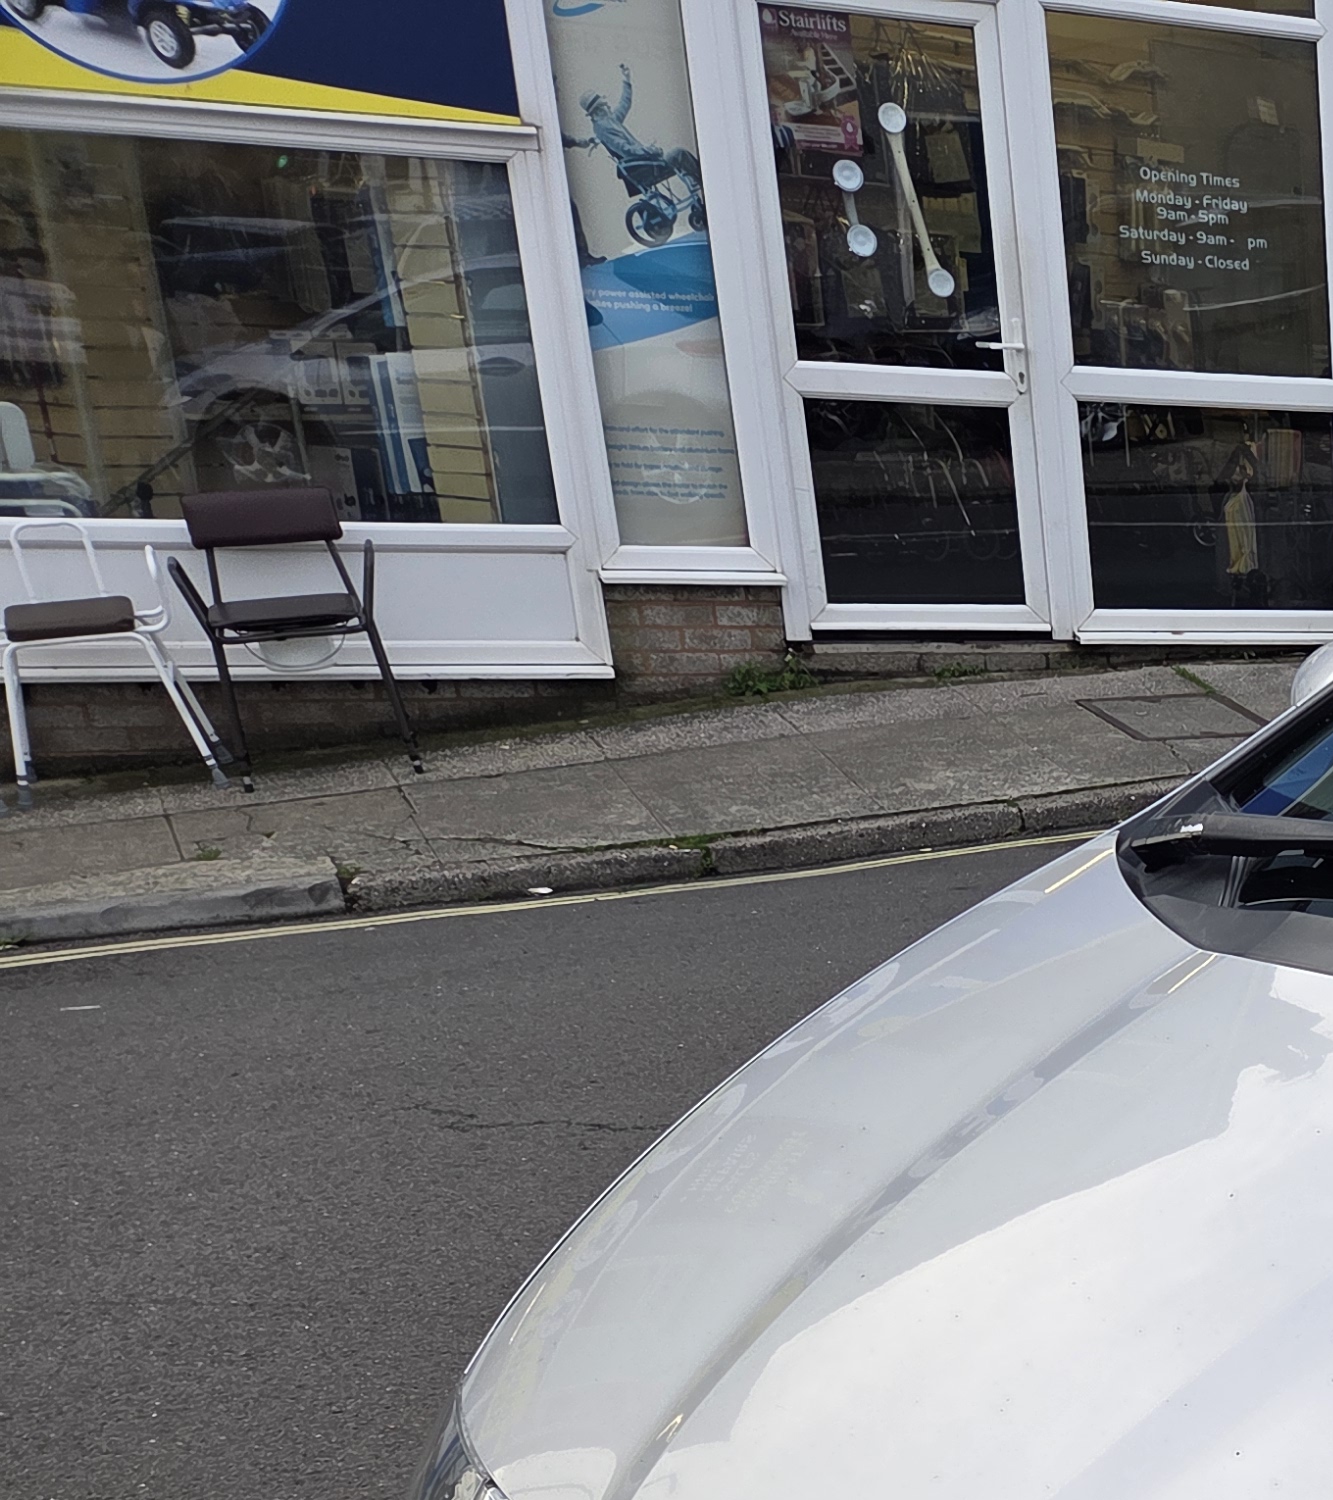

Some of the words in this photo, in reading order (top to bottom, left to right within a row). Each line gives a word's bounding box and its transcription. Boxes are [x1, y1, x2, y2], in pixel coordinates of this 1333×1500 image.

[778, 10, 847, 32] Stairlifts
[1139, 167, 1197, 187] Opening
[1200, 172, 1240, 188] Times
[1136, 189, 1191, 209] Monday
[1203, 195, 1247, 213] Friday
[1156, 206, 1188, 222] 9am
[1198, 209, 1229, 226] 5pm
[1119, 225, 1186, 245] Saturday
[1196, 231, 1227, 246] 9am
[1247, 238, 1268, 250] pm
[1141, 250, 1195, 270] Sunday
[1205, 255, 1250, 271] Closed
[614, 301, 650, 313] pushing
